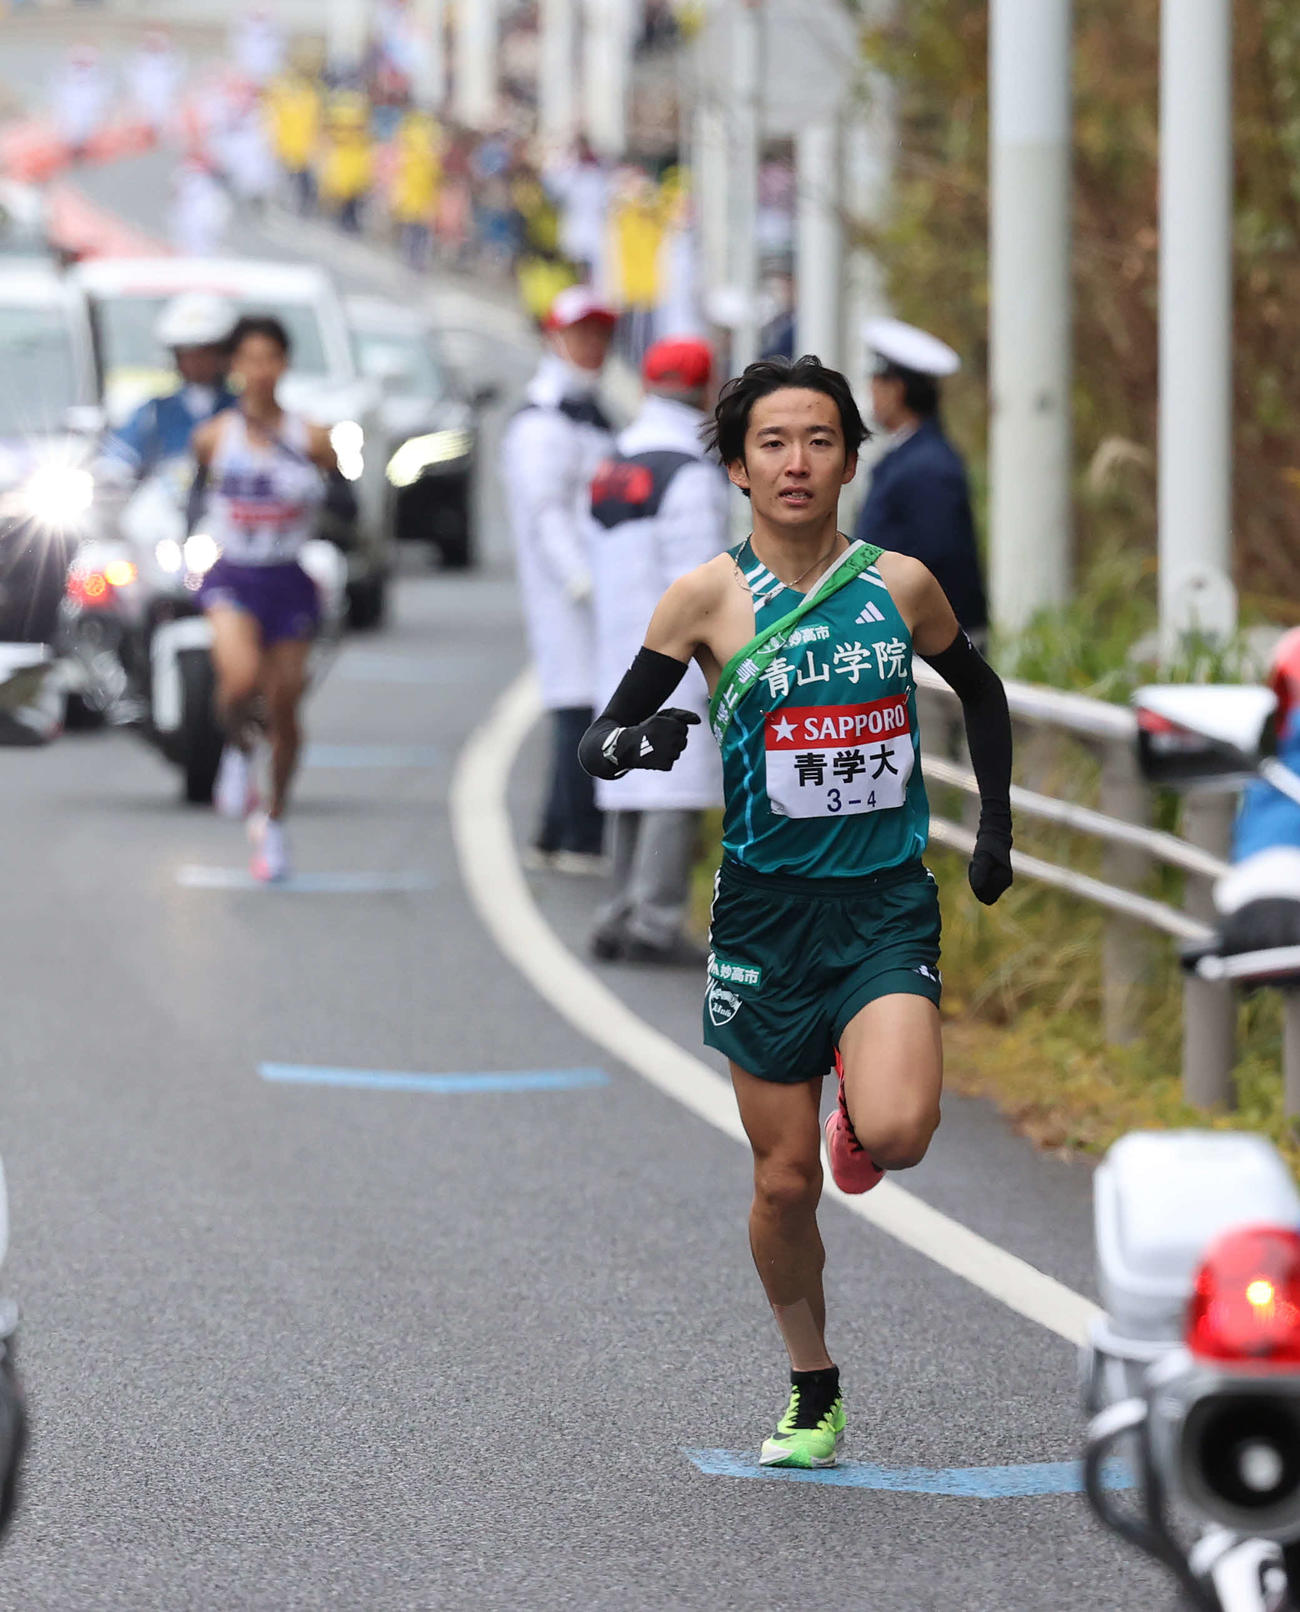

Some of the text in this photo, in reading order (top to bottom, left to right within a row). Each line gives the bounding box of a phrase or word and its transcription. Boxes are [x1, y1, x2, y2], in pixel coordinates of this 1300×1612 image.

[759, 637, 908, 698] 青山学院
[803, 705, 906, 741] SAPPORO
[794, 744, 899, 787] 青学大
